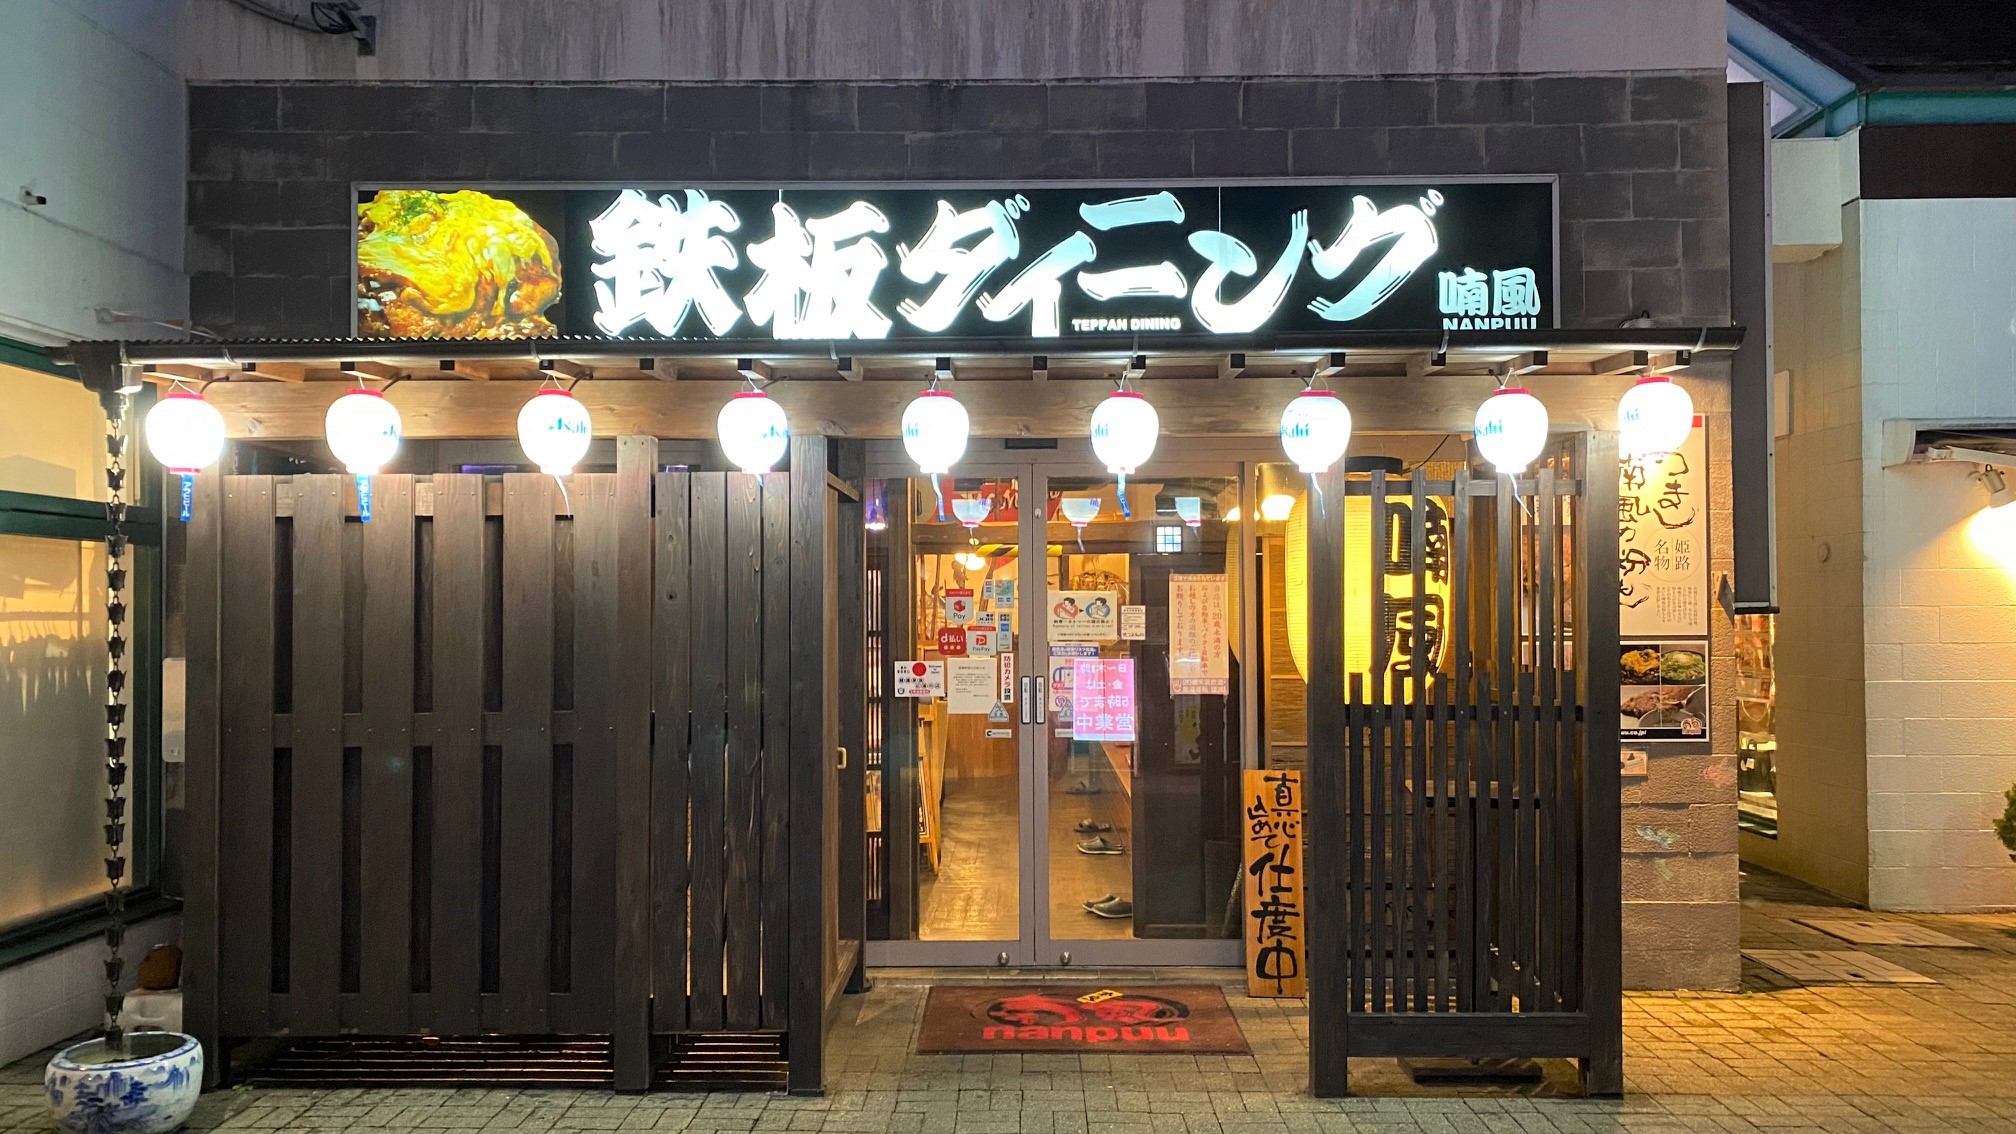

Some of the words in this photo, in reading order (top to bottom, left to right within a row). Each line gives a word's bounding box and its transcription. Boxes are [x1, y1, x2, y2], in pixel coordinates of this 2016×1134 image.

[588, 188, 1444, 340] 鉄板ダイニング
[1438, 267, 1541, 316] 喃風
[1071, 318, 1128, 331] TEPPAN
[1130, 317, 1181, 330] DINING
[1653, 539, 1671, 571] 名物
[1675, 538, 1691, 571] 姫路
[940, 633, 964, 643] d払い
[1263, 773, 1300, 838] 真心
[1249, 844, 1300, 995] 仕度中
[983, 1025, 1189, 1043] nanpuu
